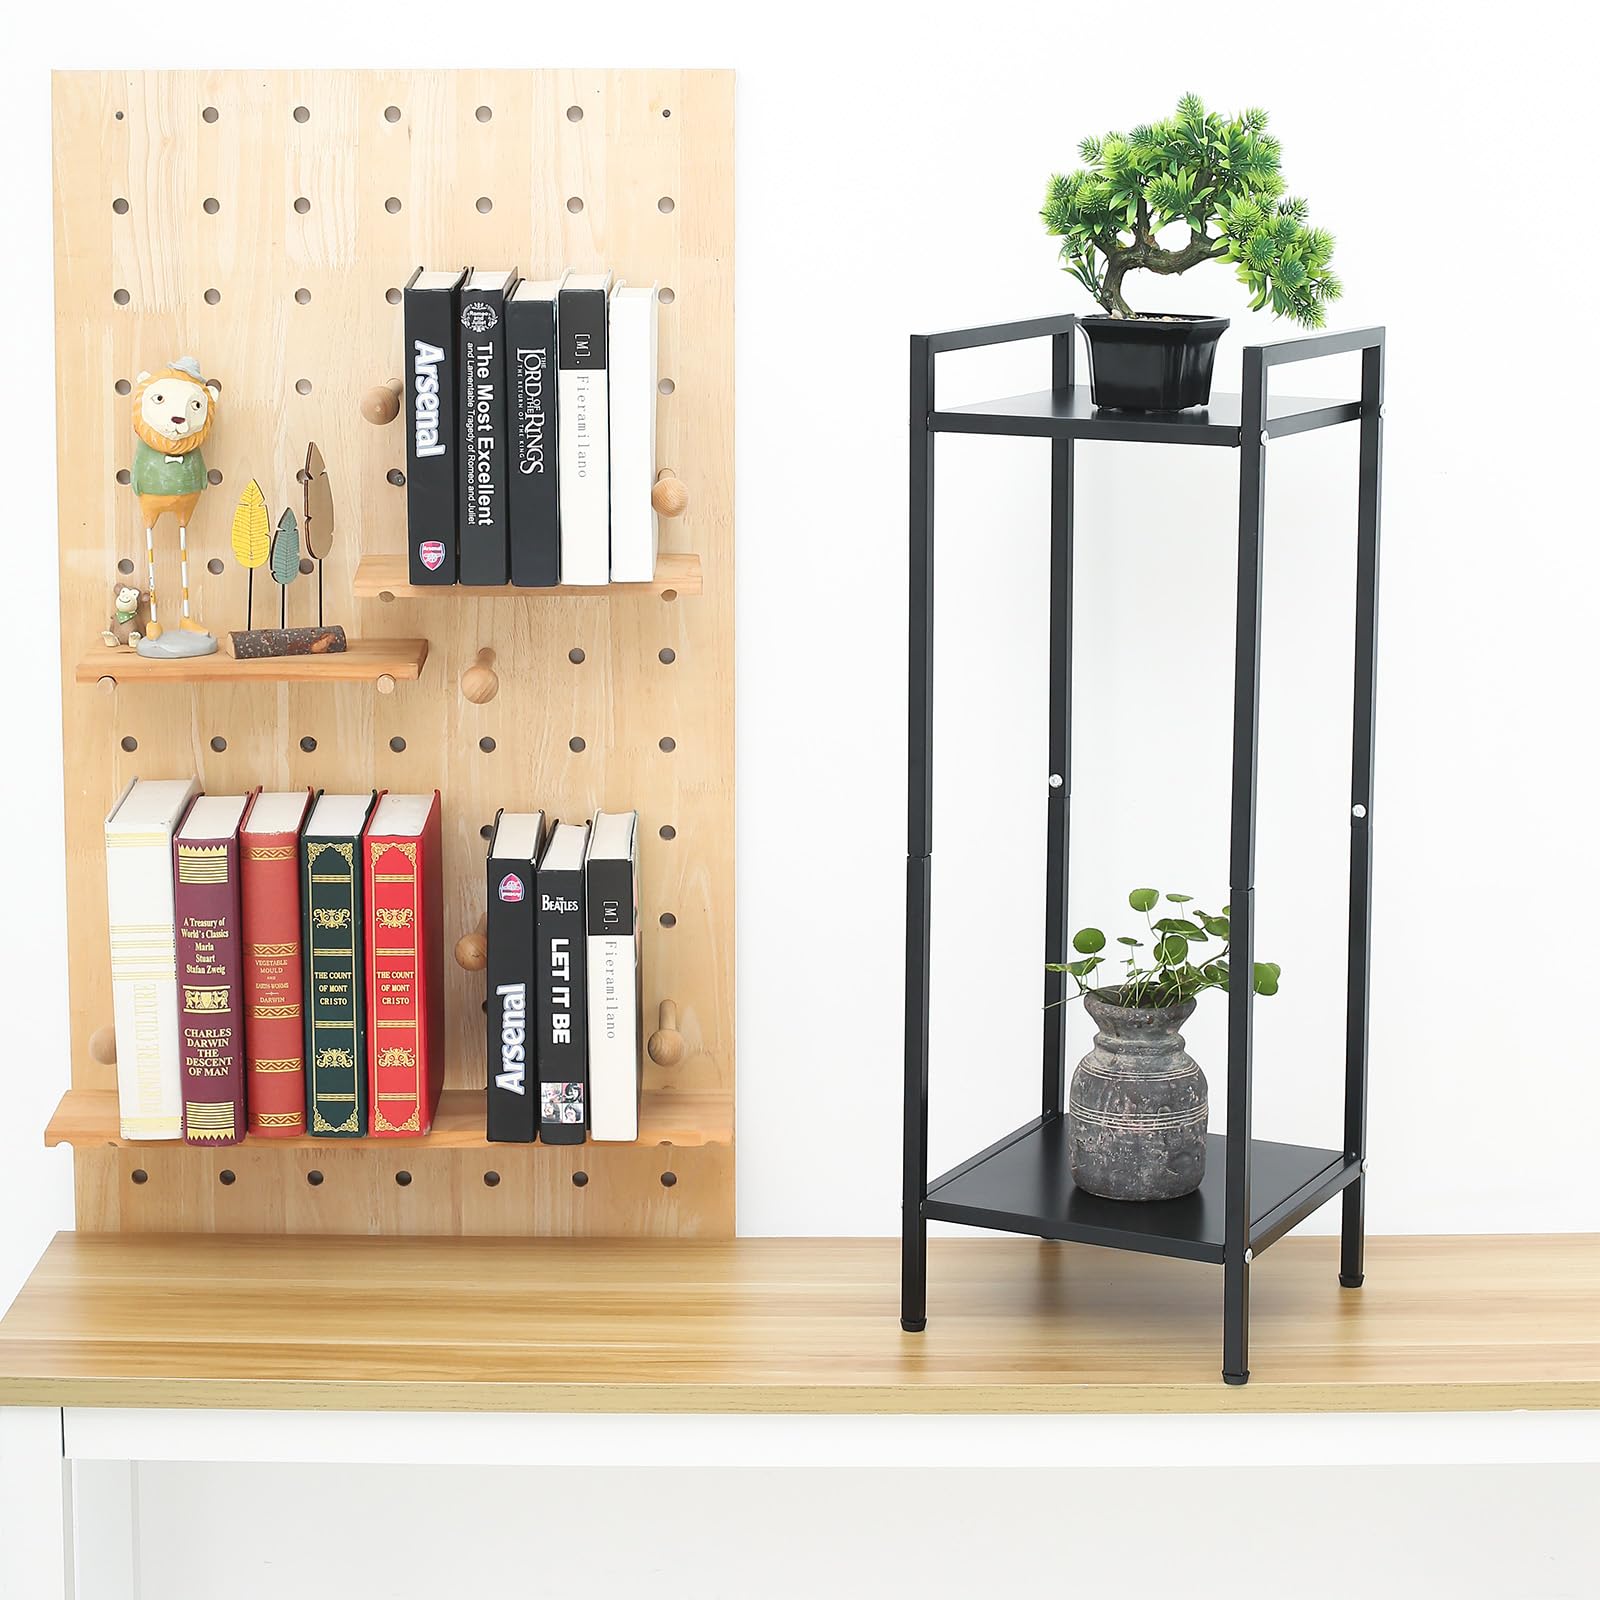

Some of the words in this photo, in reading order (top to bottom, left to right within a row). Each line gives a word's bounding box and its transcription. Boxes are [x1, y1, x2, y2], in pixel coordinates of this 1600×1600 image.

[466, 342, 475, 359] and
[574, 333, 591, 364] [M].
[477, 341, 493, 379] The
[516, 347, 546, 397] LORD
[466, 360, 476, 408] Lamentable
[414, 339, 446, 458] Arsenal
[526, 396, 535, 414] THE
[533, 398, 541, 411] OF
[477, 384, 494, 432] Most
[518, 411, 524, 420] OF
[465, 409, 476, 443] Tragedy
[576, 376, 590, 478] Fieramilano
[467, 443, 475, 455] of
[519, 411, 545, 475] RINGS
[467, 454, 476, 485] Romeo
[477, 437, 494, 526] Excellent
[467, 485, 476, 502] and
[467, 502, 476, 526] Juliet
[541, 894, 579, 914] BEATLES
[183, 917, 190, 926] A
[189, 918, 217, 929] Treasury
[218, 917, 226, 926] of
[603, 901, 619, 930] [M].
[205, 929, 229, 939] Classics
[195, 953, 215, 963] Stuart
[551, 938, 570, 982] LET
[206, 965, 226, 975] Zweig
[314, 971, 328, 979] THE
[329, 971, 352, 980] COUNT
[376, 971, 390, 979] THE
[391, 971, 414, 980] COUNT
[318, 985, 328, 993] OF
[329, 984, 348, 993] MONT
[381, 984, 391, 993] OF
[392, 984, 410, 993] MONT
[605, 941, 619, 1039] Fieramilano
[259, 996, 285, 1004] DARWIN
[319, 997, 348, 1006] CRISTO
[381, 997, 410, 1005] CRISTO
[551, 986, 570, 1009] IT
[184, 1027, 232, 1038] CHARLES
[552, 1013, 571, 1044] BE
[187, 1038, 229, 1048] DARWIN
[495, 982, 526, 1096] Arsenal
[186, 1056, 233, 1067] DESCENT
[197, 1048, 220, 1058] THE
[188, 1067, 202, 1077] OF
[204, 1066, 229, 1077] MAN
